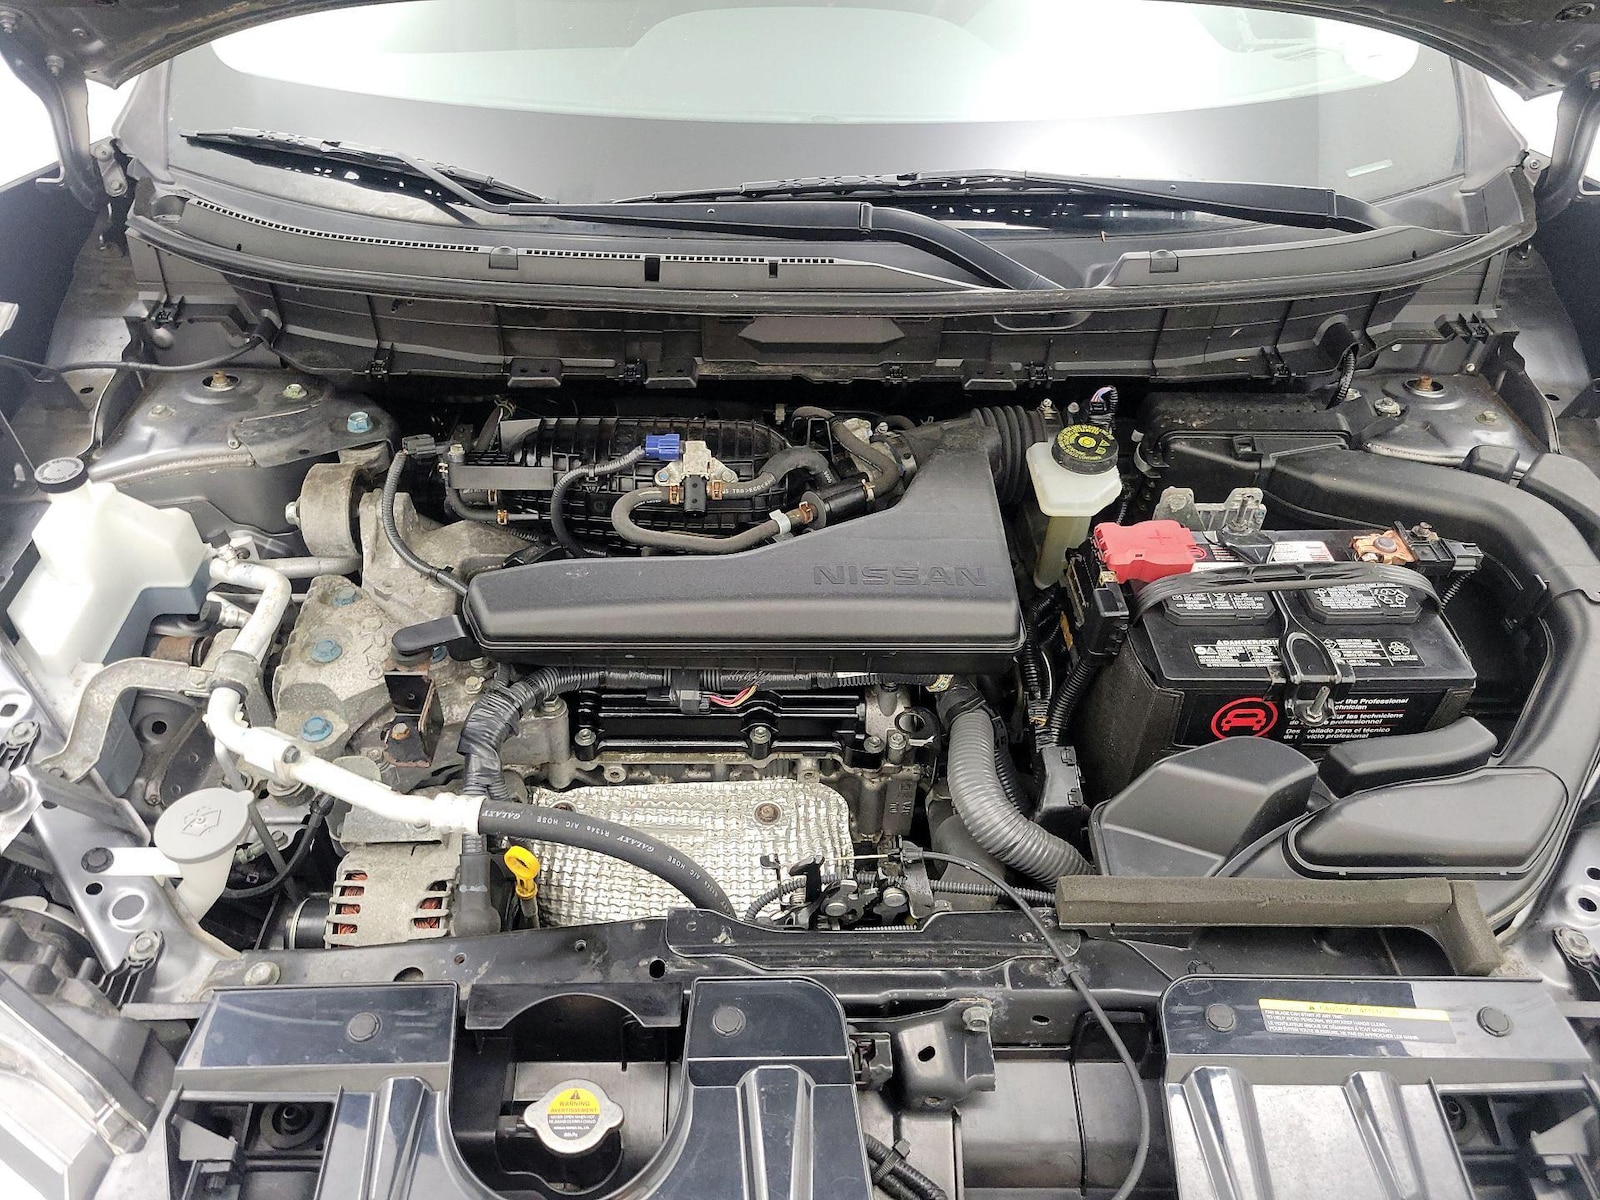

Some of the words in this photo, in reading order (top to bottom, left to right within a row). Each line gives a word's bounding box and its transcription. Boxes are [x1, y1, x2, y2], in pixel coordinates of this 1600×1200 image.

[813, 565, 986, 587] NISSAN
[481, 809, 521, 820] GALAXY
[536, 815, 558, 825] HOSE
[565, 820, 580, 830] A/C
[616, 834, 655, 853] GALAXY
[666, 854, 686, 870] HOSE
[689, 868, 701, 880] A/C
